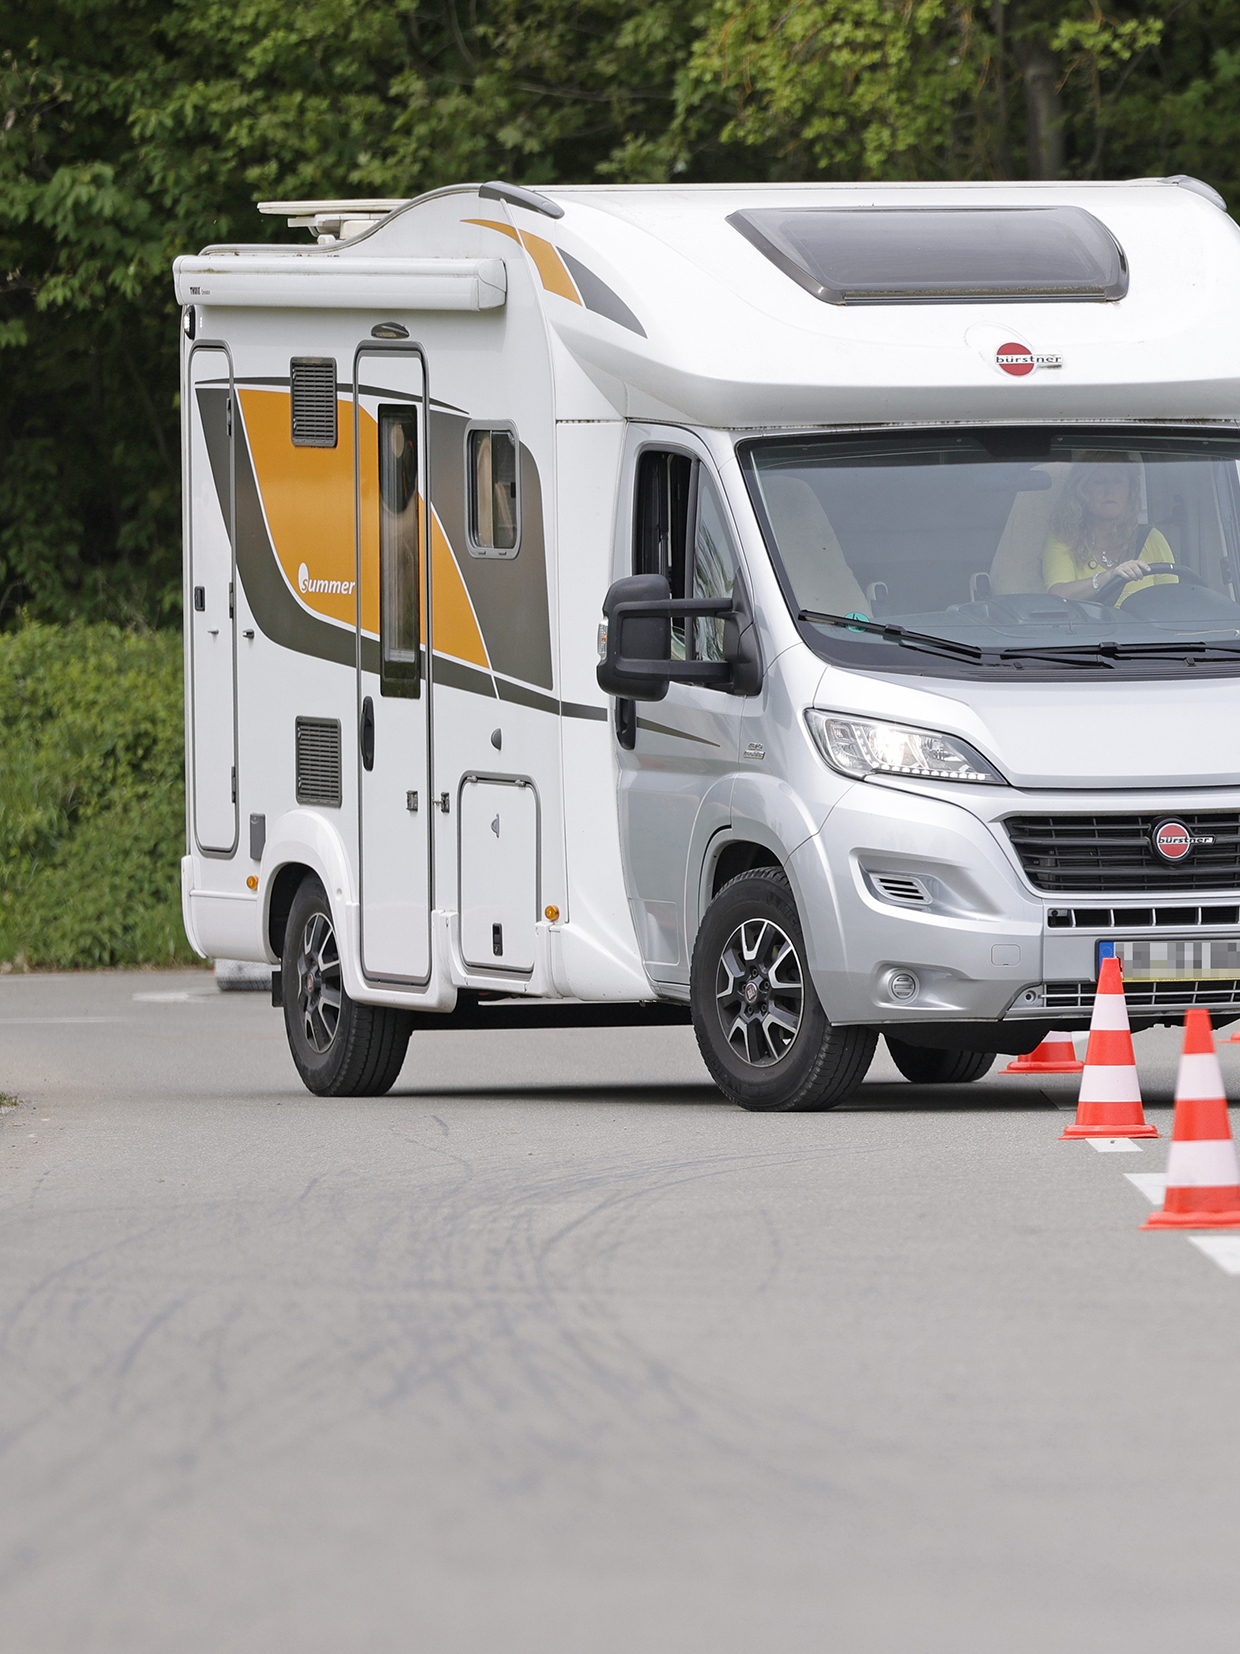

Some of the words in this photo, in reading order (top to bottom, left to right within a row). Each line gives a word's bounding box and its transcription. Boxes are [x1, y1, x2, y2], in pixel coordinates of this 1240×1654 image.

[996, 355, 1062, 363] bürstner
[299, 577, 356, 595] summer
[1158, 836, 1210, 844] bürstner
